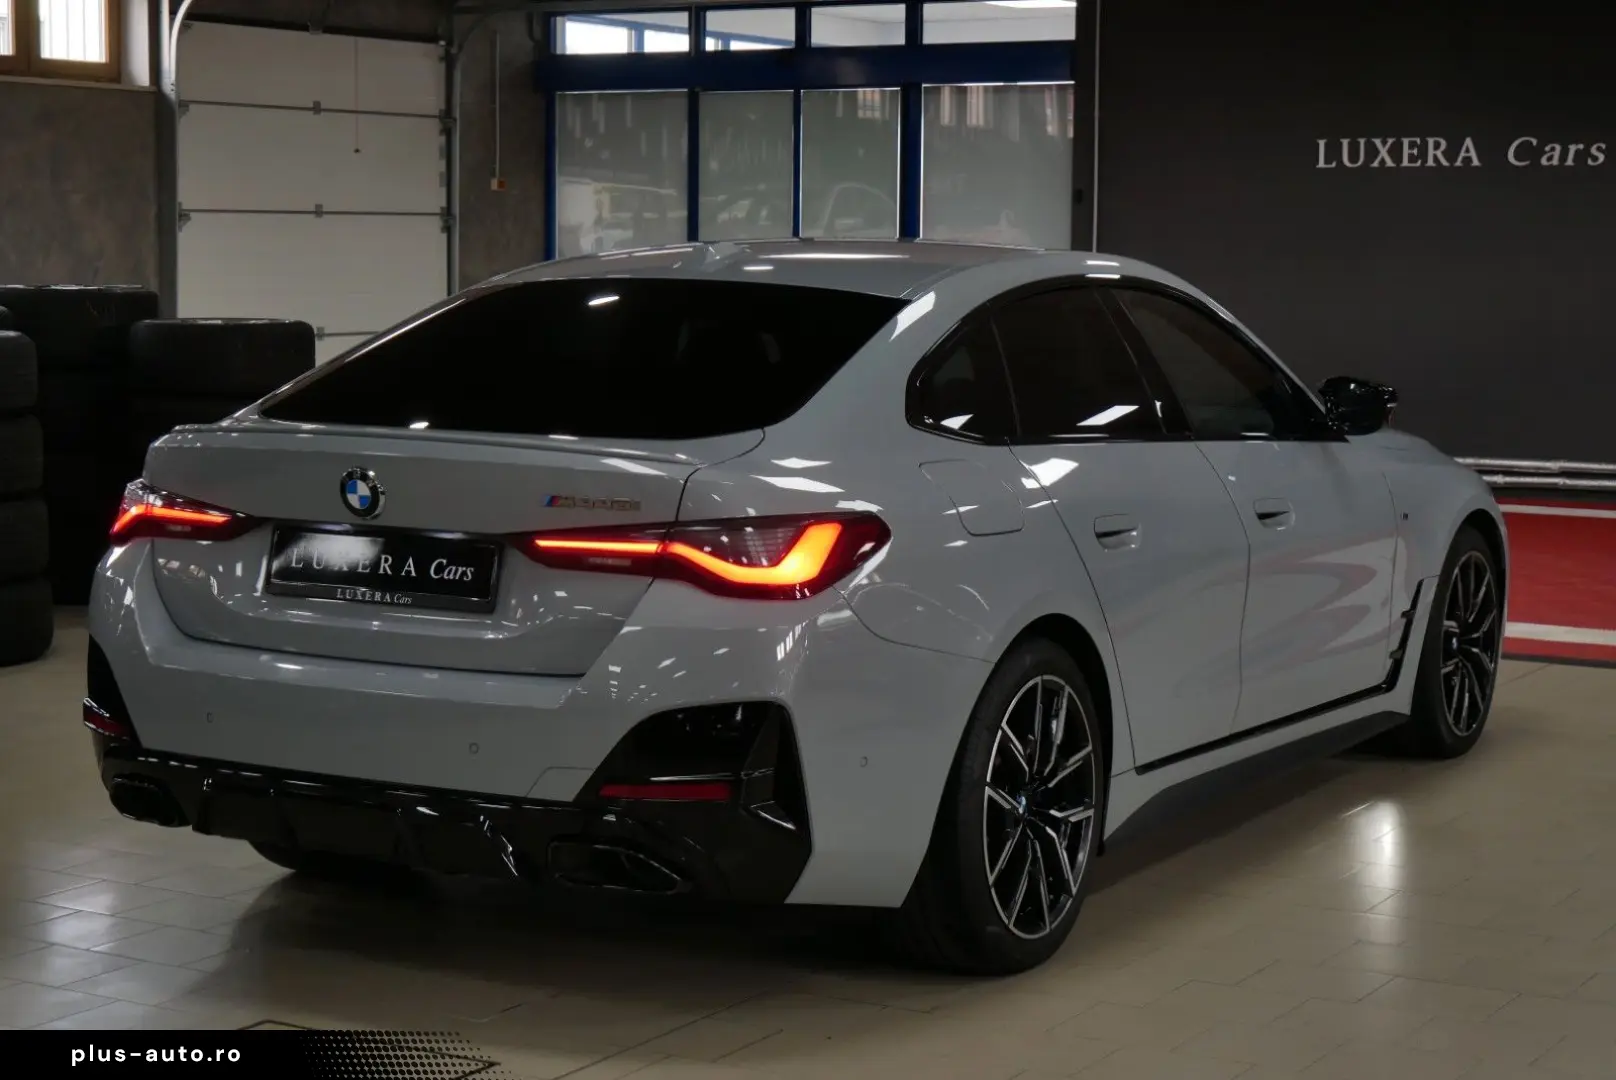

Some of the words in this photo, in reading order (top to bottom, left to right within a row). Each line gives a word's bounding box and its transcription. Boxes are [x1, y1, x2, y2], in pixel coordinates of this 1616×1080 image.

[1315, 137, 1482, 168] LUXERA
[1507, 136, 1607, 167] Cars
[430, 558, 475, 581] Cars
[336, 588, 391, 603] LUXERA
[394, 593, 412, 604] Cars
